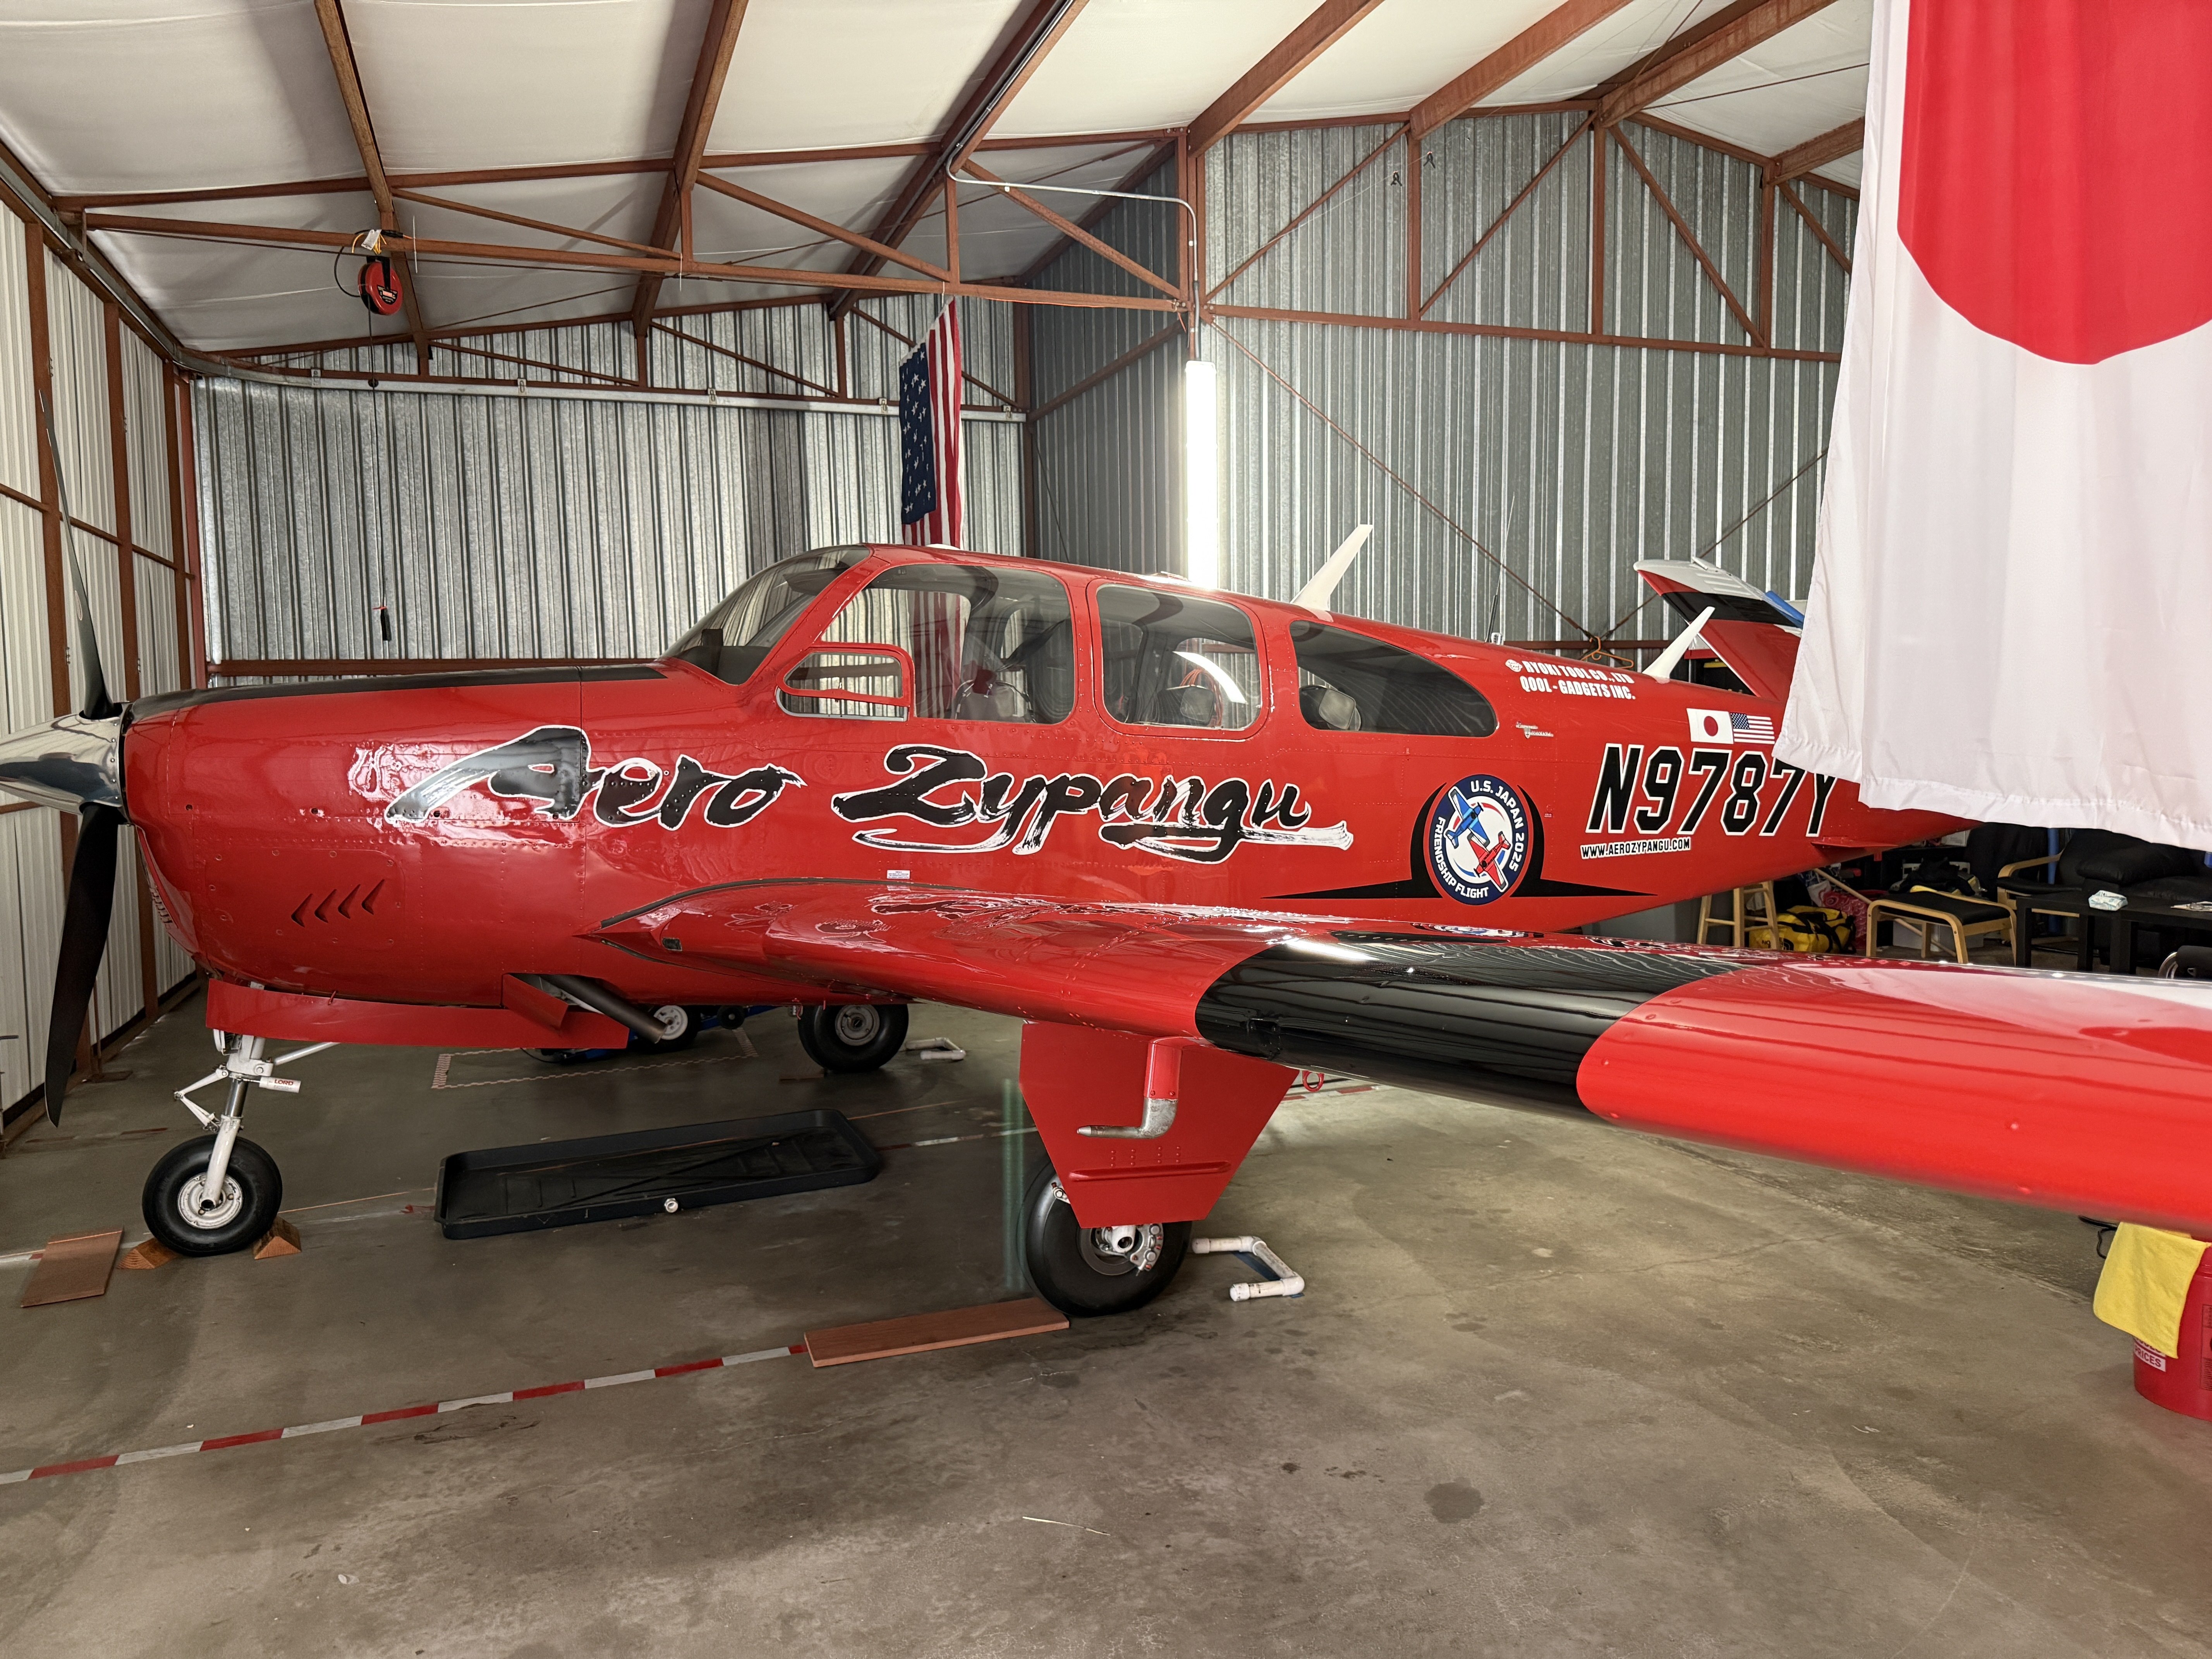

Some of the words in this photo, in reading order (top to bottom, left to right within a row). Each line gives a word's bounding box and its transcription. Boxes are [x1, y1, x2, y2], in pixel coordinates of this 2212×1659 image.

[1520, 676, 1553, 692] QOOL
[1558, 680, 1611, 698] GADGETS
[1609, 684, 1636, 700] INC.
[1521, 660, 1562, 676] RYOKI
[1558, 665, 1592, 679] TOOL
[384, 724, 807, 830] Aero
[830, 743, 1354, 865] Zypangu
[1470, 780, 1494, 793] U.S.
[1585, 743, 1838, 837] N9787Y
[1495, 785, 1524, 829] JAPAN
[1434, 816, 1457, 886] FRIENDSHIP
[1455, 883, 1489, 898] FLIGHT
[1509, 832, 1524, 872] 2025
[1581, 838, 1690, 858] WWW.AEROZYPANGU.COM
